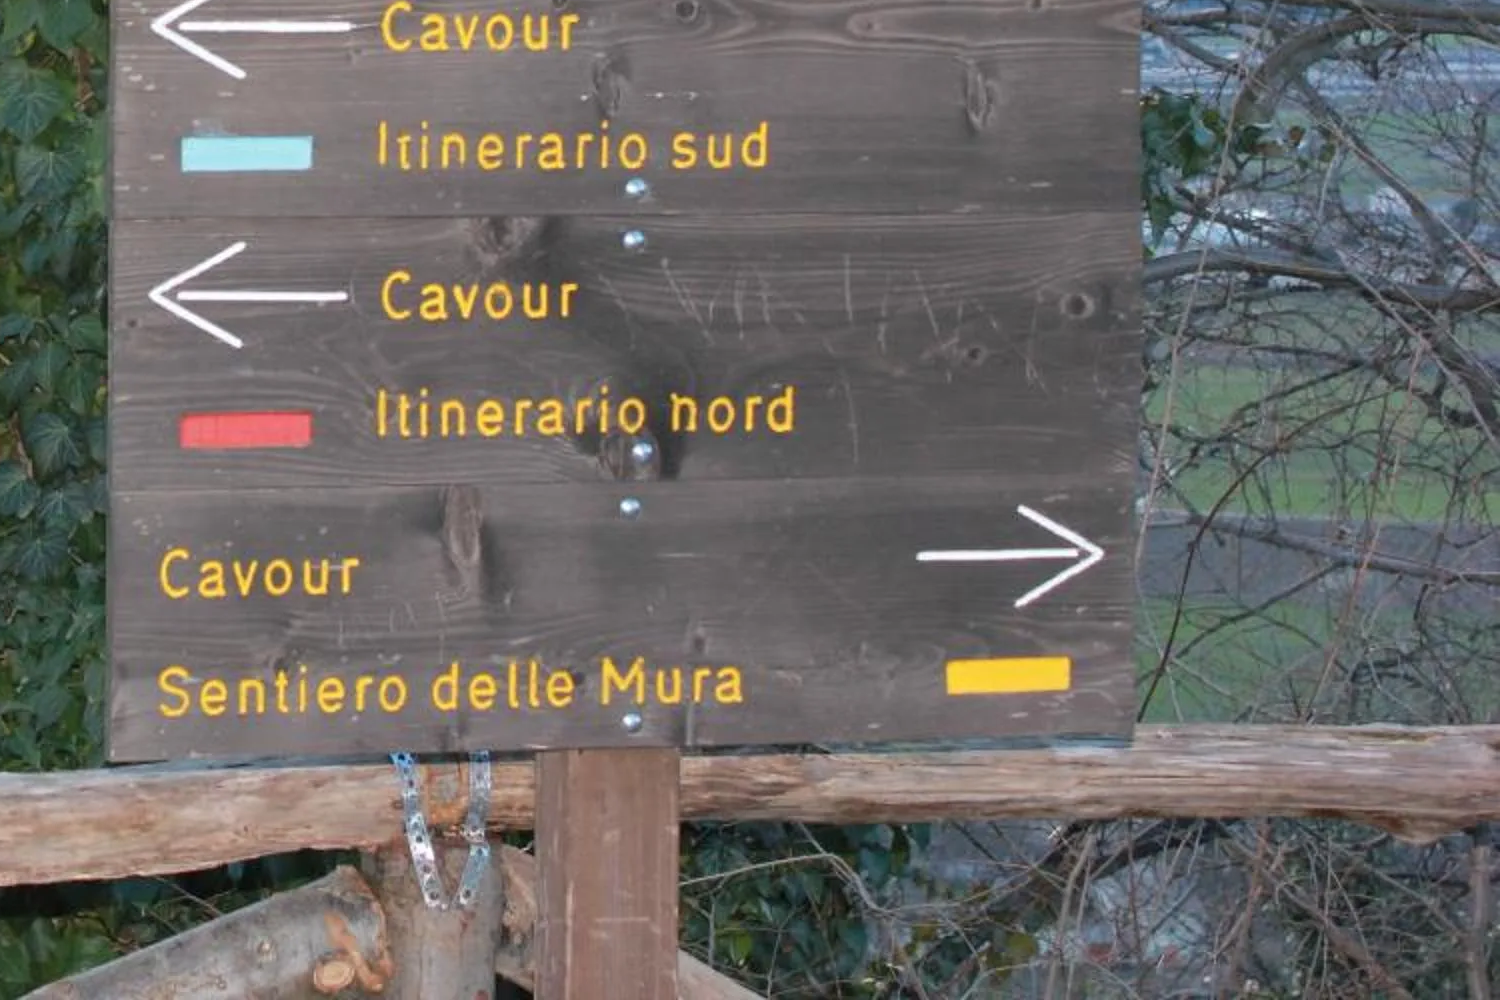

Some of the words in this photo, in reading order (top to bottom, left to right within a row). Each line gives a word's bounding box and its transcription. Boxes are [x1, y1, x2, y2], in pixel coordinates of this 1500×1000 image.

[379, 0, 581, 53] Cavour
[376, 119, 649, 172] Itinerario
[670, 119, 770, 170] sud
[380, 269, 580, 322] Cavour
[375, 386, 647, 438] Itinerario
[669, 385, 796, 434] nord
[158, 546, 360, 600] Cavour
[156, 664, 410, 718] Sentiero
[430, 659, 576, 713] delle
[598, 656, 744, 706] Mura
